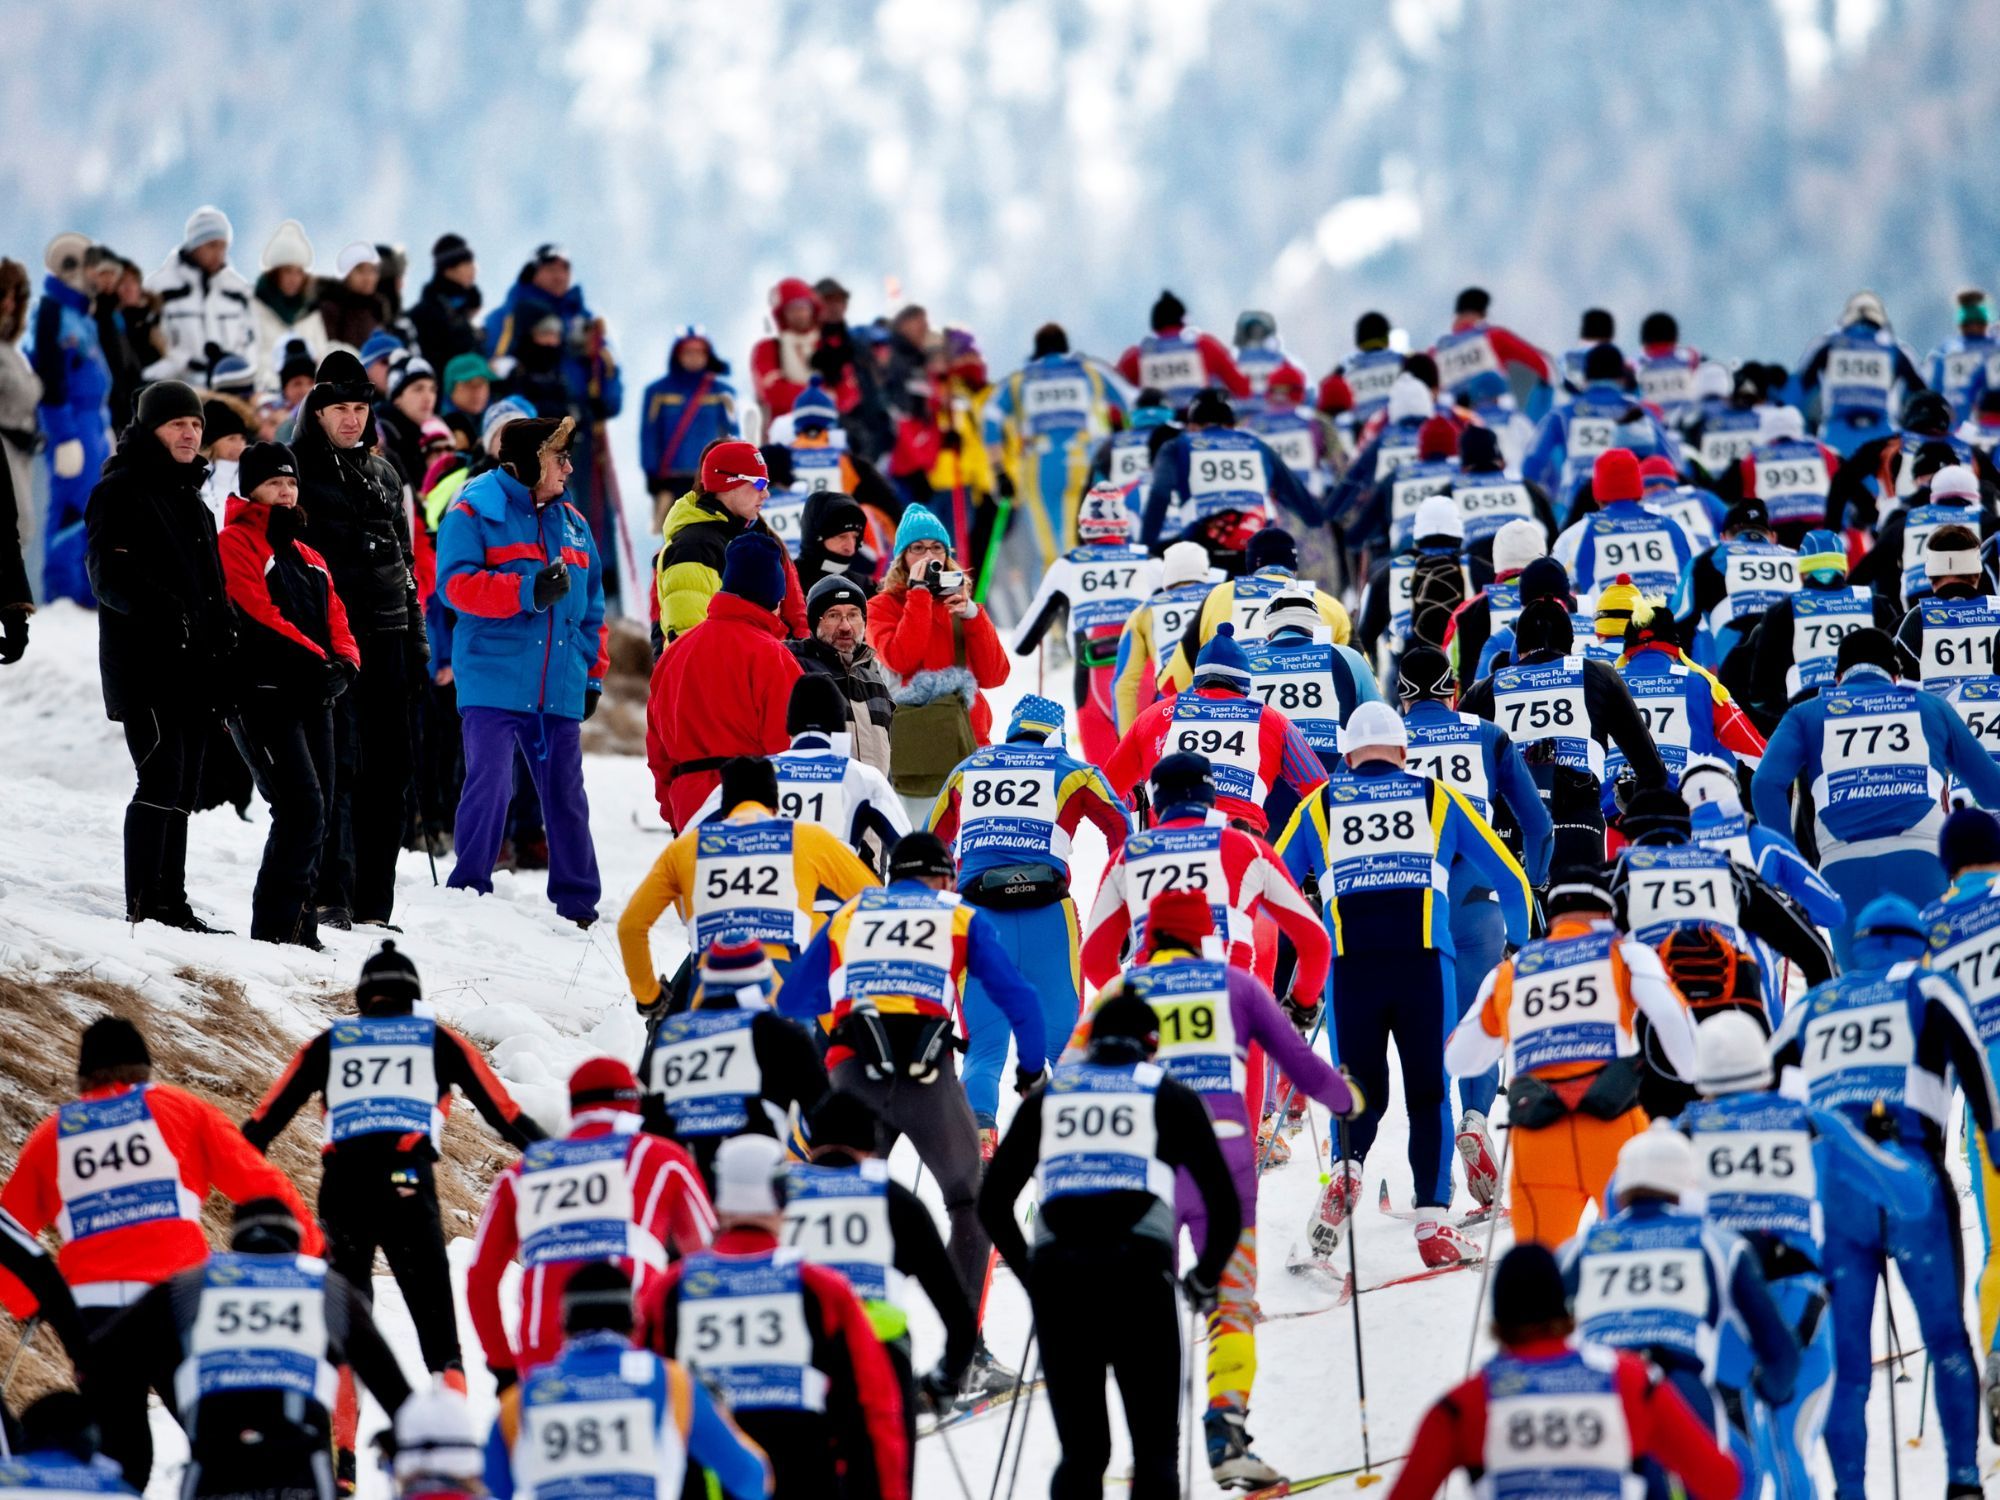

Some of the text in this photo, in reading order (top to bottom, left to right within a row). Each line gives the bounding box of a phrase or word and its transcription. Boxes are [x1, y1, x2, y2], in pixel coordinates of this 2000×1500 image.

[1201, 459, 1254, 482] 985
[1765, 467, 1816, 487] 993
[1464, 491, 1516, 511] 658
[1605, 540, 1663, 566] 916
[1081, 569, 1137, 591] 647
[1739, 561, 1794, 584] 590
[1948, 609, 1975, 617] Casse
[1273, 653, 1328, 664] Casse Rurali
[1935, 638, 1992, 666] 611
[1282, 661, 1320, 670] Trentine
[1521, 670, 1551, 681] Casse
[1530, 675, 1572, 687] Trentine
[1629, 677, 1683, 687] Casse Rurali
[1637, 684, 1675, 694] Trentine
[1257, 682, 1322, 709] 788
[1853, 697, 1885, 707] Casse
[1864, 703, 1907, 712] Trentine
[1202, 706, 1259, 714] Casse Rurali
[1505, 698, 1574, 733] 758
[1178, 730, 1245, 756] 694
[1416, 724, 1478, 738] Casse Rurali
[1427, 732, 1470, 743] Trentine
[1836, 723, 1910, 758] 773
[781, 762, 842, 774] Casse Rurali
[996, 752, 1025, 763] Casse
[1004, 757, 1045, 767] Trentine
[791, 769, 833, 780] Trentine
[972, 779, 1041, 807] 862
[1359, 781, 1422, 794] Casse Rurali
[1370, 789, 1413, 799] Trentine
[1848, 782, 1926, 800] MARCIALONGA
[780, 792, 824, 822] 91
[727, 831, 790, 846] Casse Rurali
[1342, 811, 1415, 846] 838
[974, 835, 1048, 850] MARCIALONGA
[707, 866, 779, 899] 542
[1005, 885, 1036, 894] adidas
[1137, 862, 1209, 901] 725
[1352, 871, 1430, 888] MARCIALONGA
[1642, 880, 1716, 909] 751
[863, 920, 936, 950] 742
[1523, 976, 1598, 1018] 655
[1162, 1006, 1214, 1041] 19
[1816, 1016, 1892, 1060] 795
[342, 1057, 414, 1088] 871
[663, 1045, 736, 1087] 627
[1056, 1105, 1135, 1138] 506
[73, 1133, 151, 1180] 646
[1708, 1144, 1795, 1178] 645
[531, 1173, 608, 1215] 720
[782, 1214, 869, 1253] 710
[1596, 1262, 1684, 1298] 785
[217, 1301, 303, 1334] 554
[697, 1310, 783, 1350] 513
[543, 1416, 630, 1460] 981
[1509, 1409, 1605, 1450] 889
